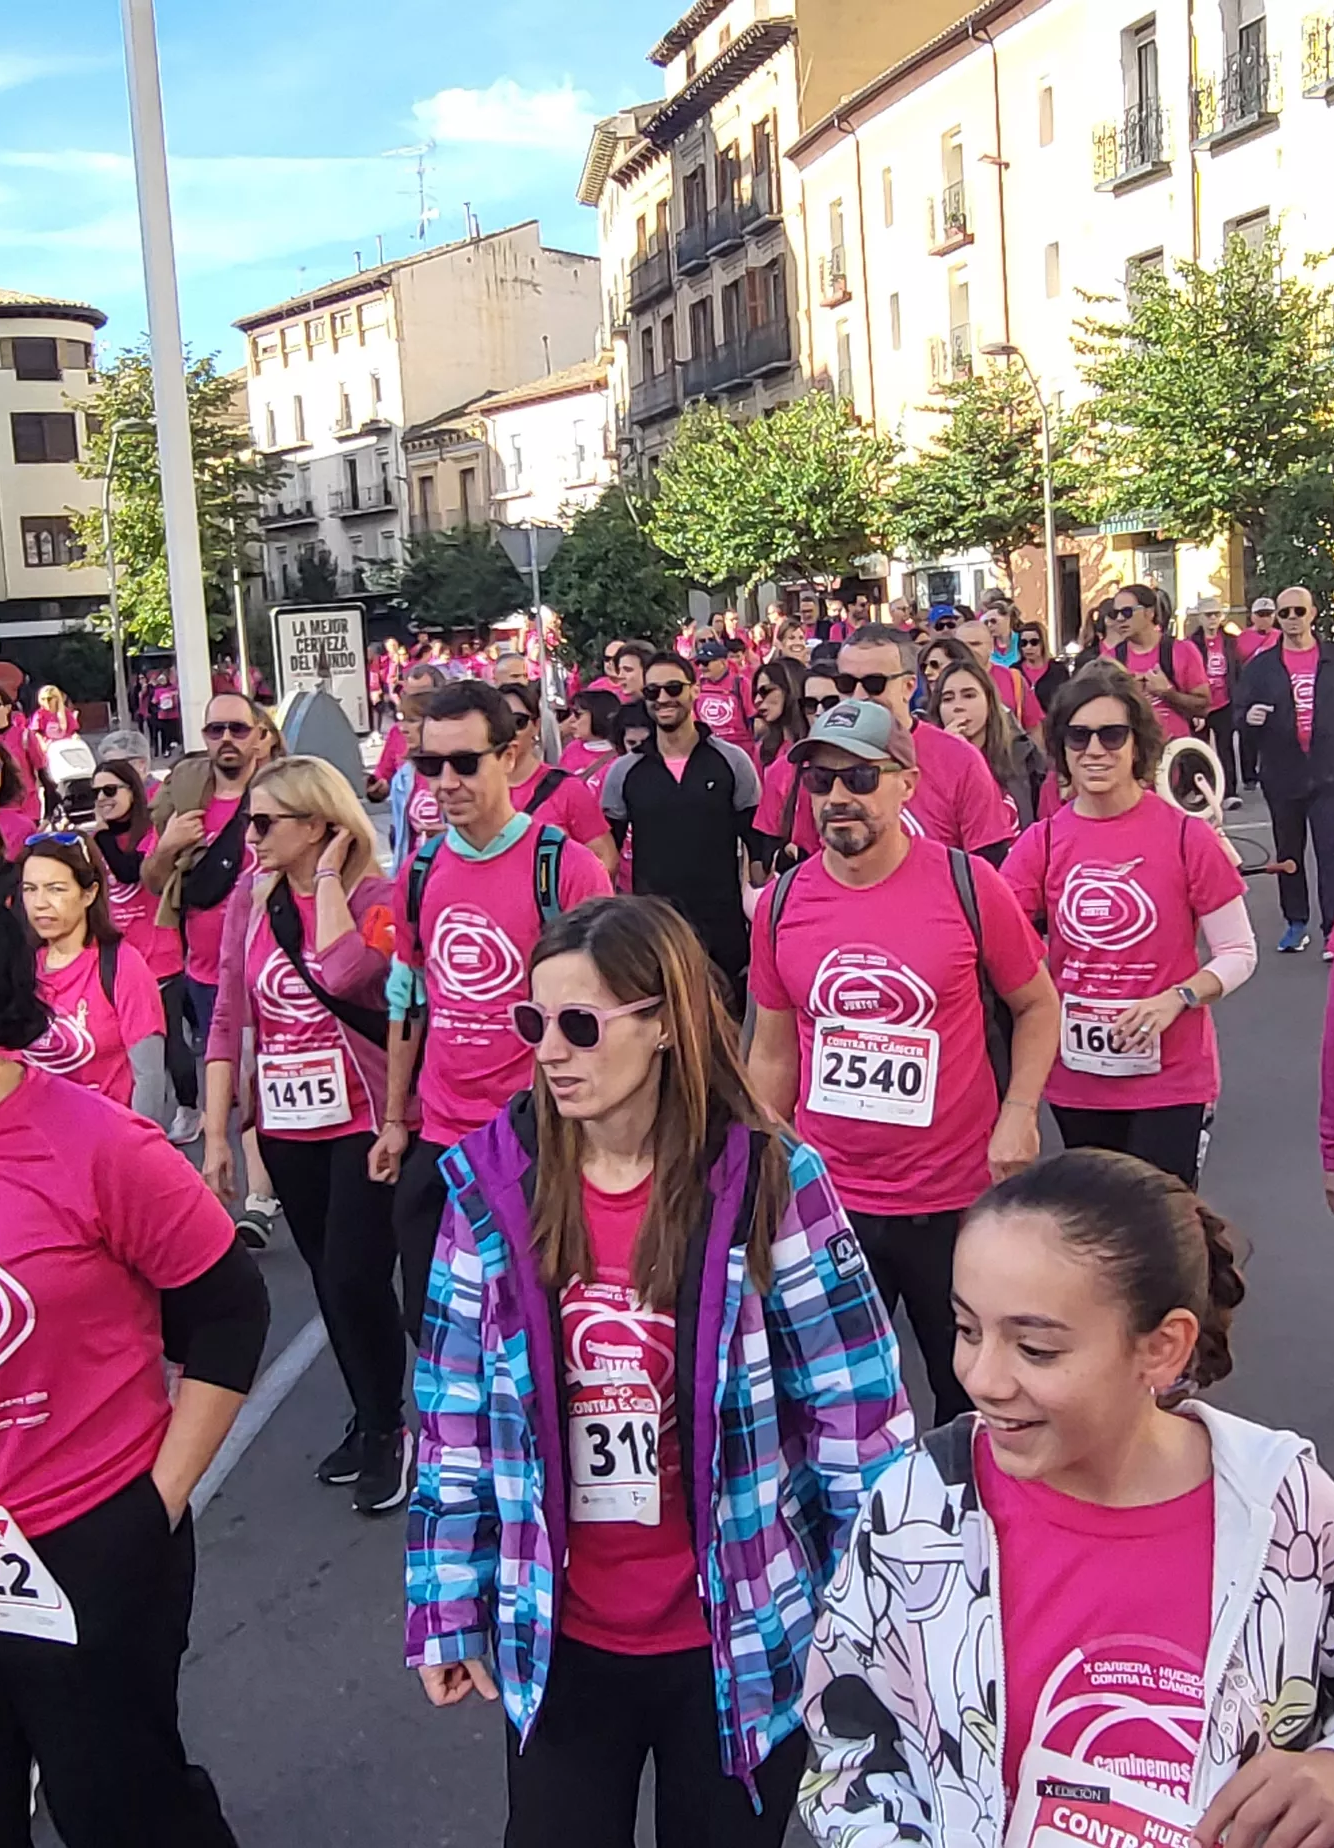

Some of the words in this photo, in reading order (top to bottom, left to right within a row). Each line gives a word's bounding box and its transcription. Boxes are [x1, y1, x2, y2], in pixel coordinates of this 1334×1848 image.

[292, 620, 307, 636] LA
[310, 619, 349, 635] MEJOR
[290, 654, 311, 671] DEL
[826, 1036, 866, 1050] CONTRA
[822, 1052, 922, 1097] 2540
[267, 1077, 336, 1108] 1415
[585, 1420, 658, 1477] 318
[1094, 1661, 1152, 1675] CARRERA
[1091, 1674, 1140, 1685] CONTRA
[1142, 1676, 1157, 1689] EL
[1044, 1784, 1054, 1796] X
[1053, 1806, 1154, 1848] CONTR
[1144, 1820, 1192, 1848] HUES
